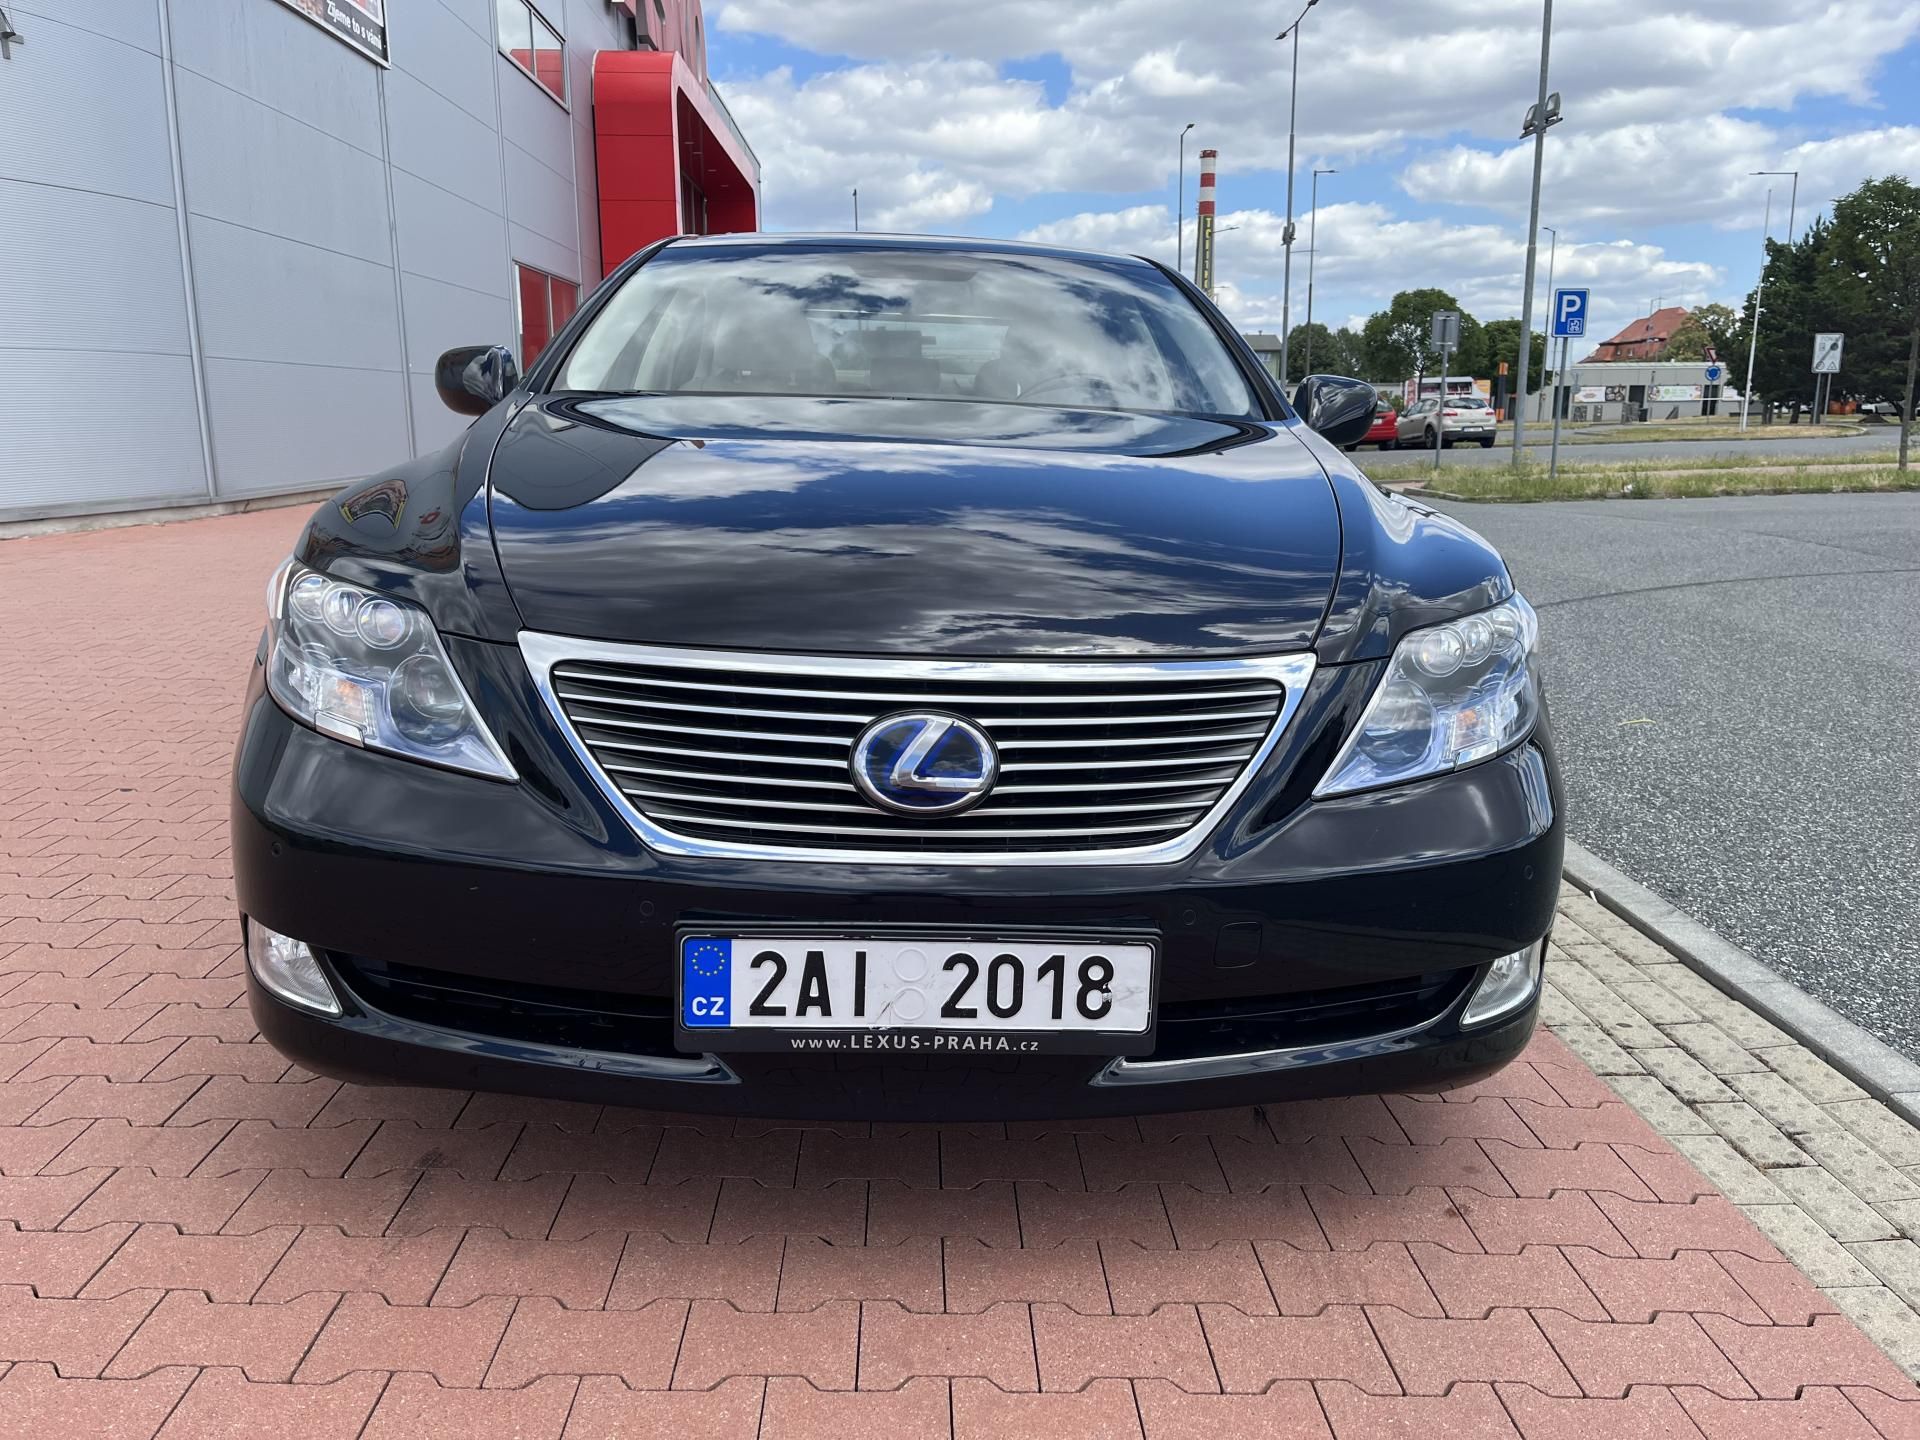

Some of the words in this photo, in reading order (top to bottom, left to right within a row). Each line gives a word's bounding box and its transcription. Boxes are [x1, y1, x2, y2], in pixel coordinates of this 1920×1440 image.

[352, 17, 360, 35] to
[361, 26, 366, 39] s
[1560, 294, 1582, 323] P
[749, 950, 867, 1017] 2AI
[940, 952, 1115, 1020] 2018
[692, 996, 725, 1016] CZ
[790, 1034, 1039, 1051] www.LEXUS-PRAHA.cz
